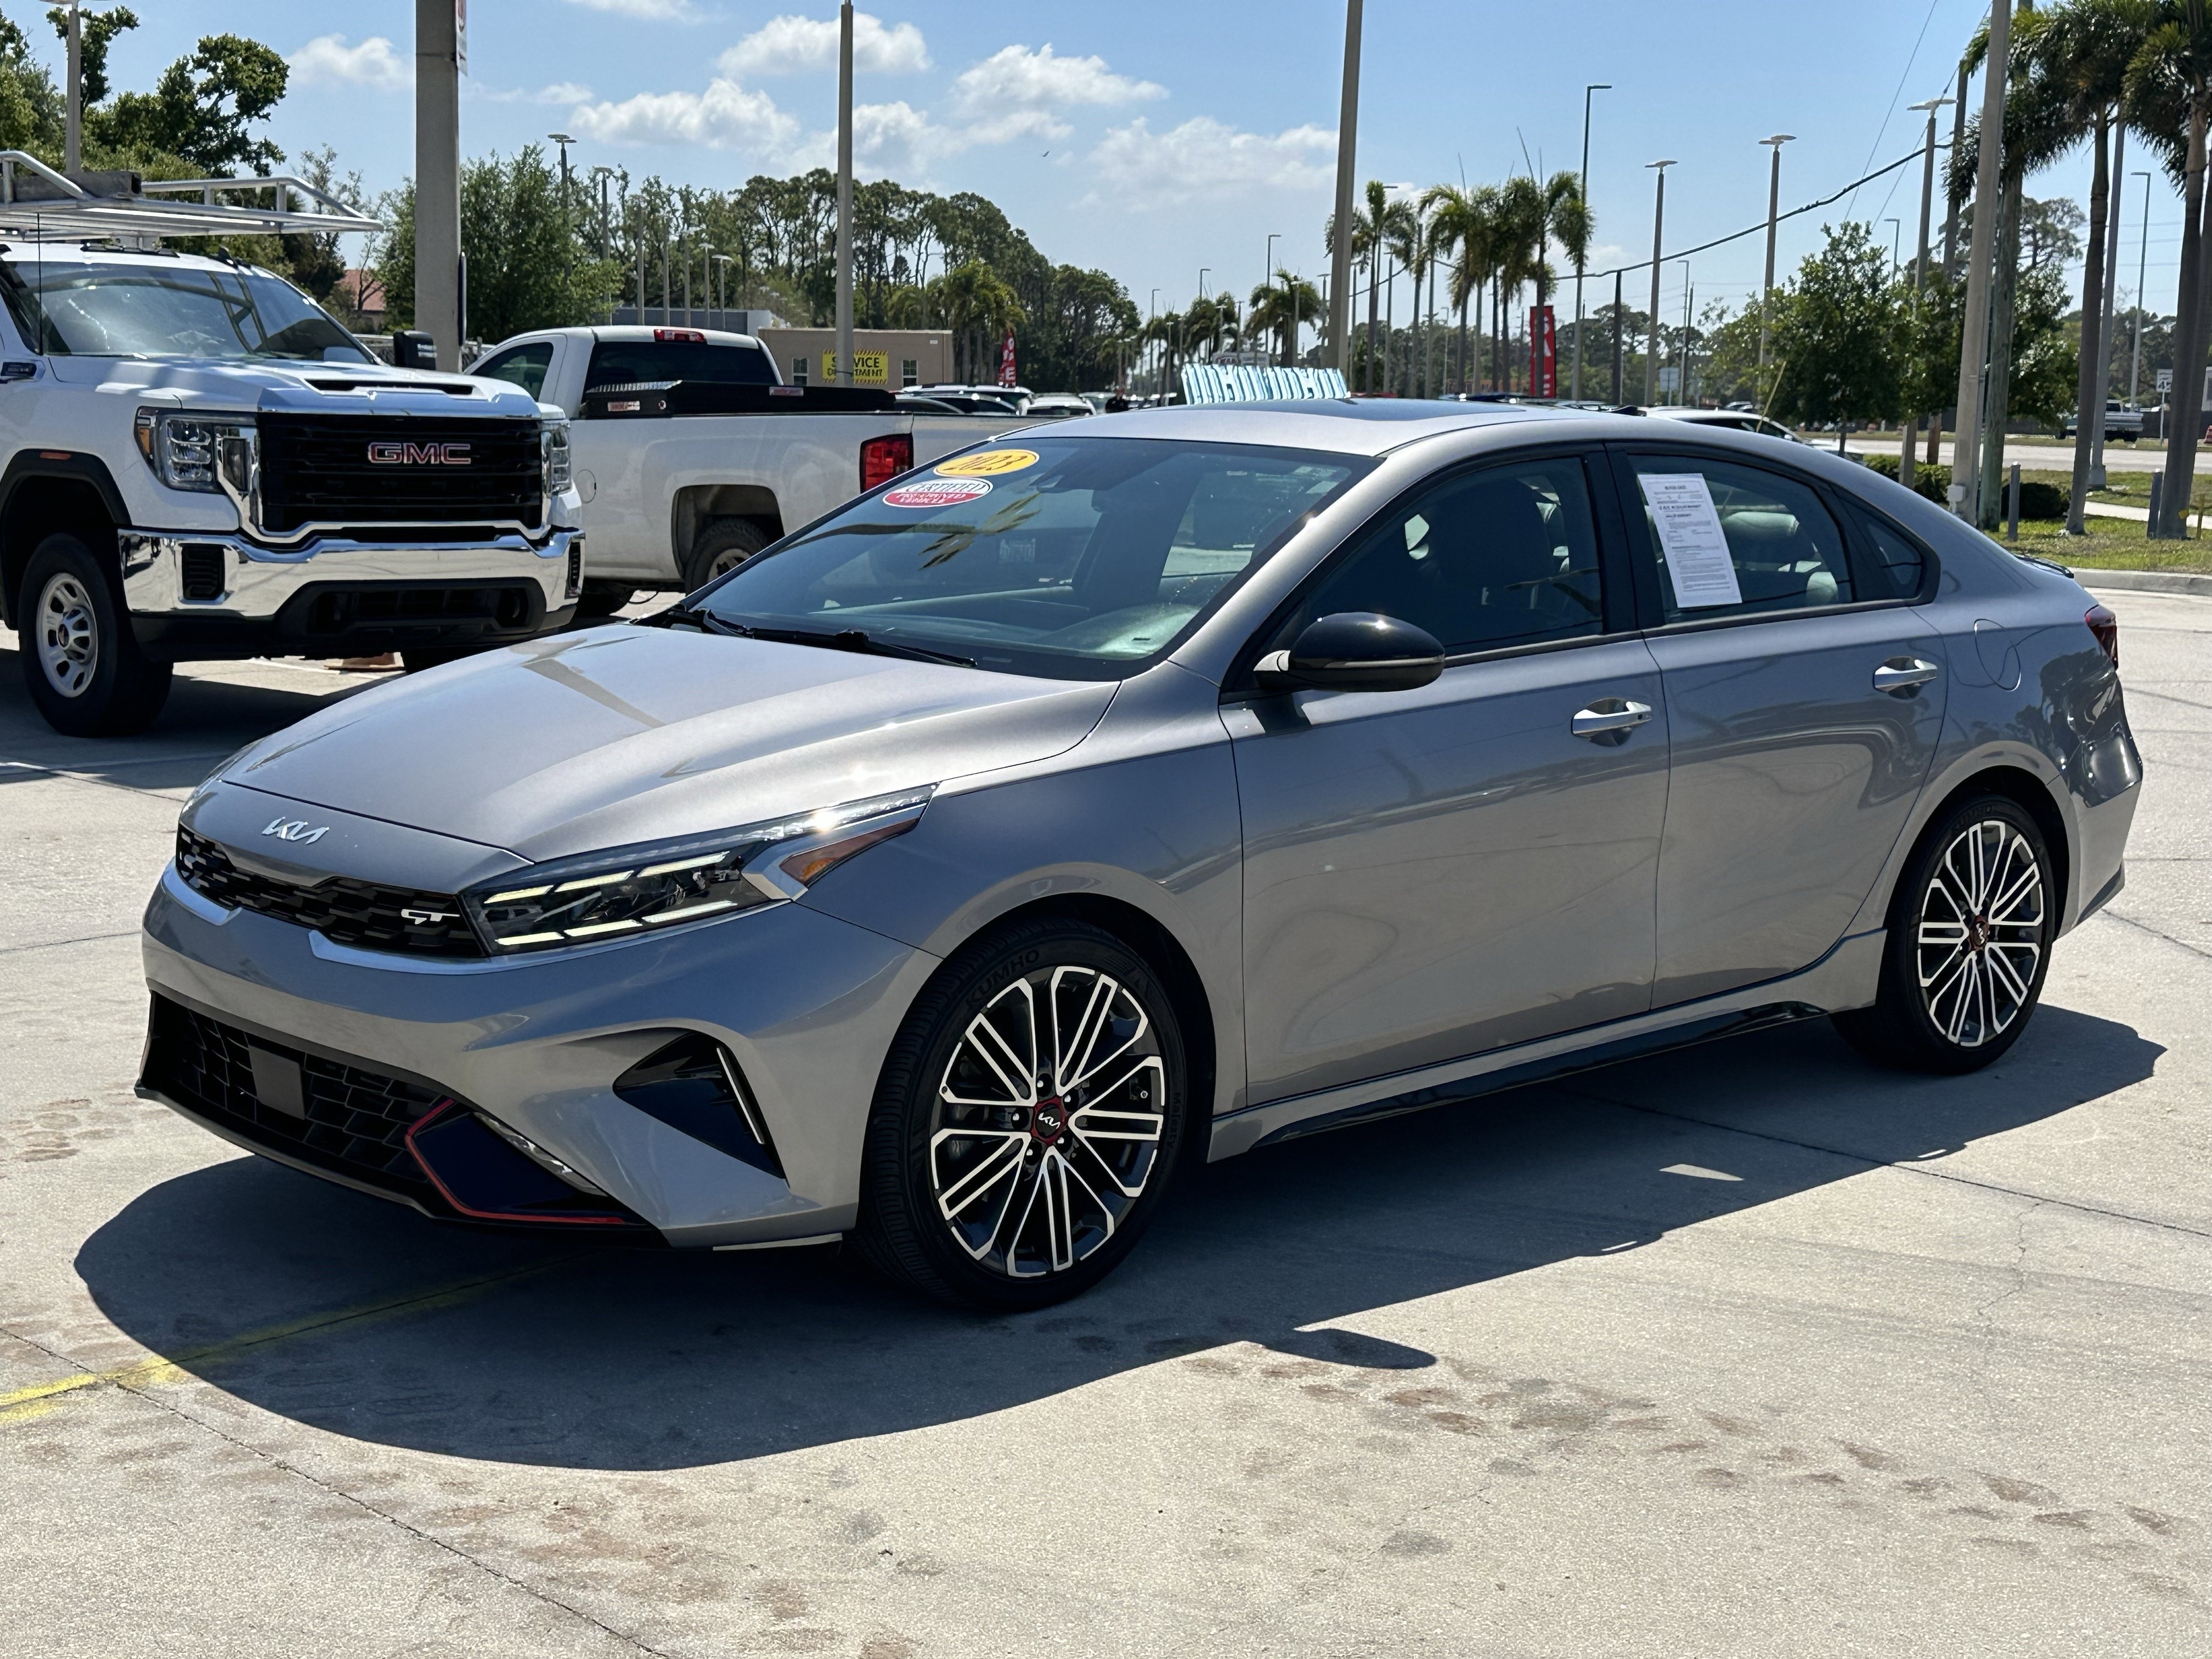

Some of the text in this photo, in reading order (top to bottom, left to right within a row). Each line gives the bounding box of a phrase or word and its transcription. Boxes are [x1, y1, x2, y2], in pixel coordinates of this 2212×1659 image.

[831, 357, 880, 368] SVICE
[368, 442, 471, 464] GMC
[943, 455, 1028, 471] 2023
[400, 909, 460, 925] GT
[965, 948, 1040, 1009] KUMHO
